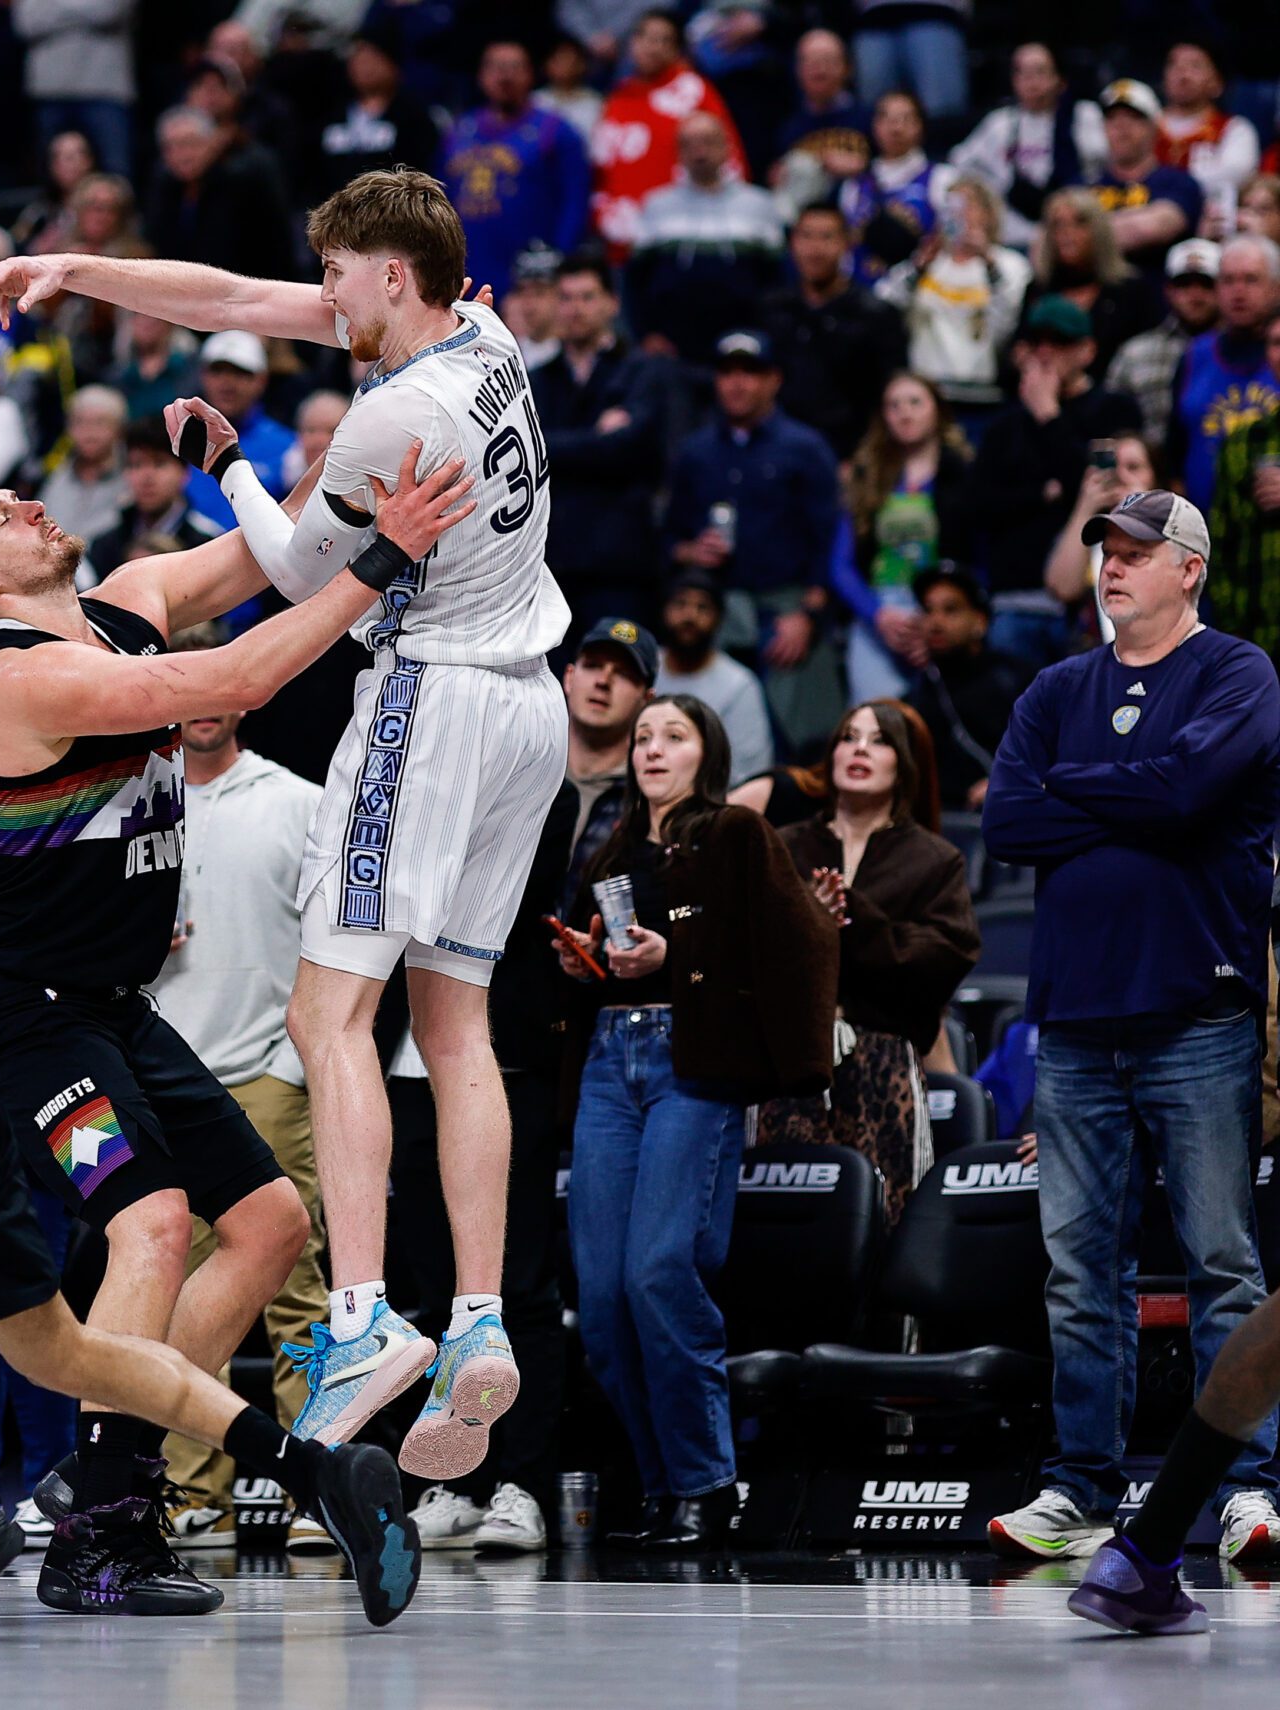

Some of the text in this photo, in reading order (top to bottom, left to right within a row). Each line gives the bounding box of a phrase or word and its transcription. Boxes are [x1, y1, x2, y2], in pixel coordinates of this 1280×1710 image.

[468, 354, 526, 436] LOVERING
[125, 818, 185, 880] DENE
[34, 1076, 96, 1131] NUGGETS
[739, 1163, 841, 1186] UMB
[862, 1481, 970, 1503] UMB
[853, 1515, 962, 1529] RESERVE
